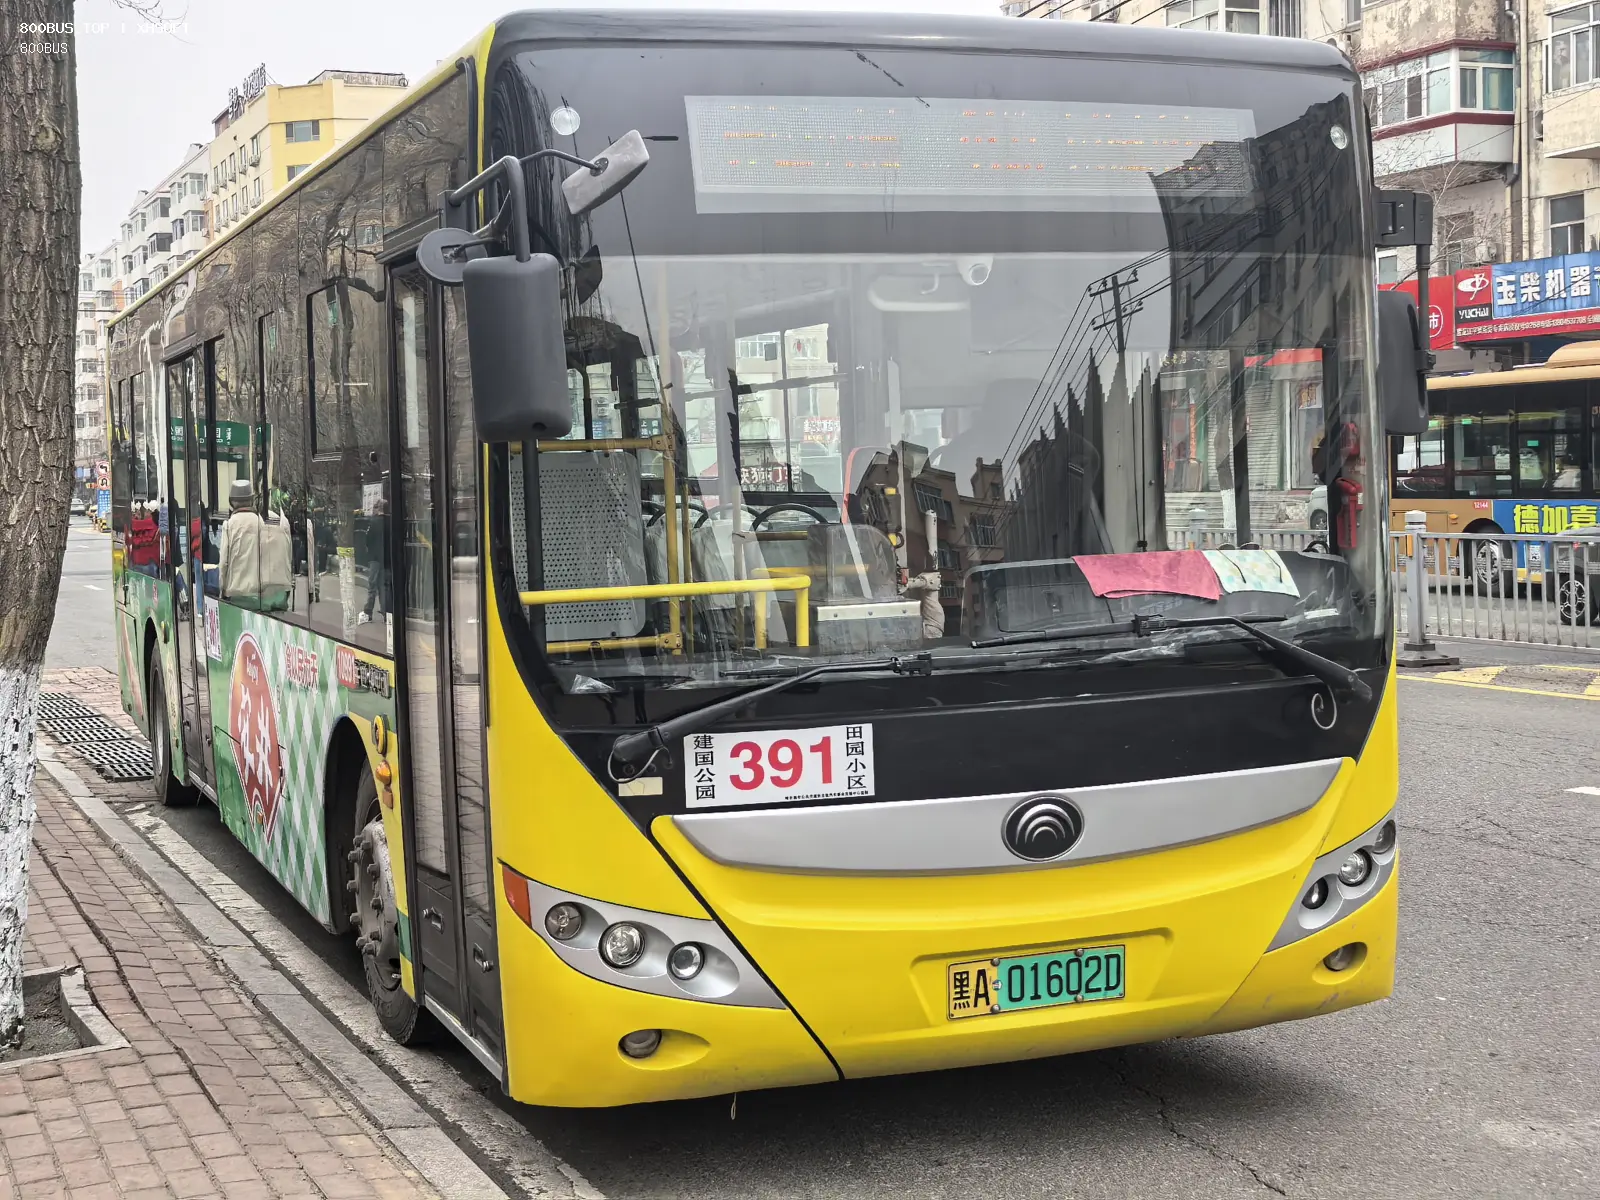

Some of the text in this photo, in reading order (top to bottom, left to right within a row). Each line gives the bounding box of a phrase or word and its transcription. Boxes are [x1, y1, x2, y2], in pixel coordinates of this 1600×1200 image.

[693, 734, 716, 800] 建国公园
[729, 735, 833, 791] 391
[845, 726, 867, 790] 田园小区
[952, 953, 1121, 1011] 黑A 01602D
